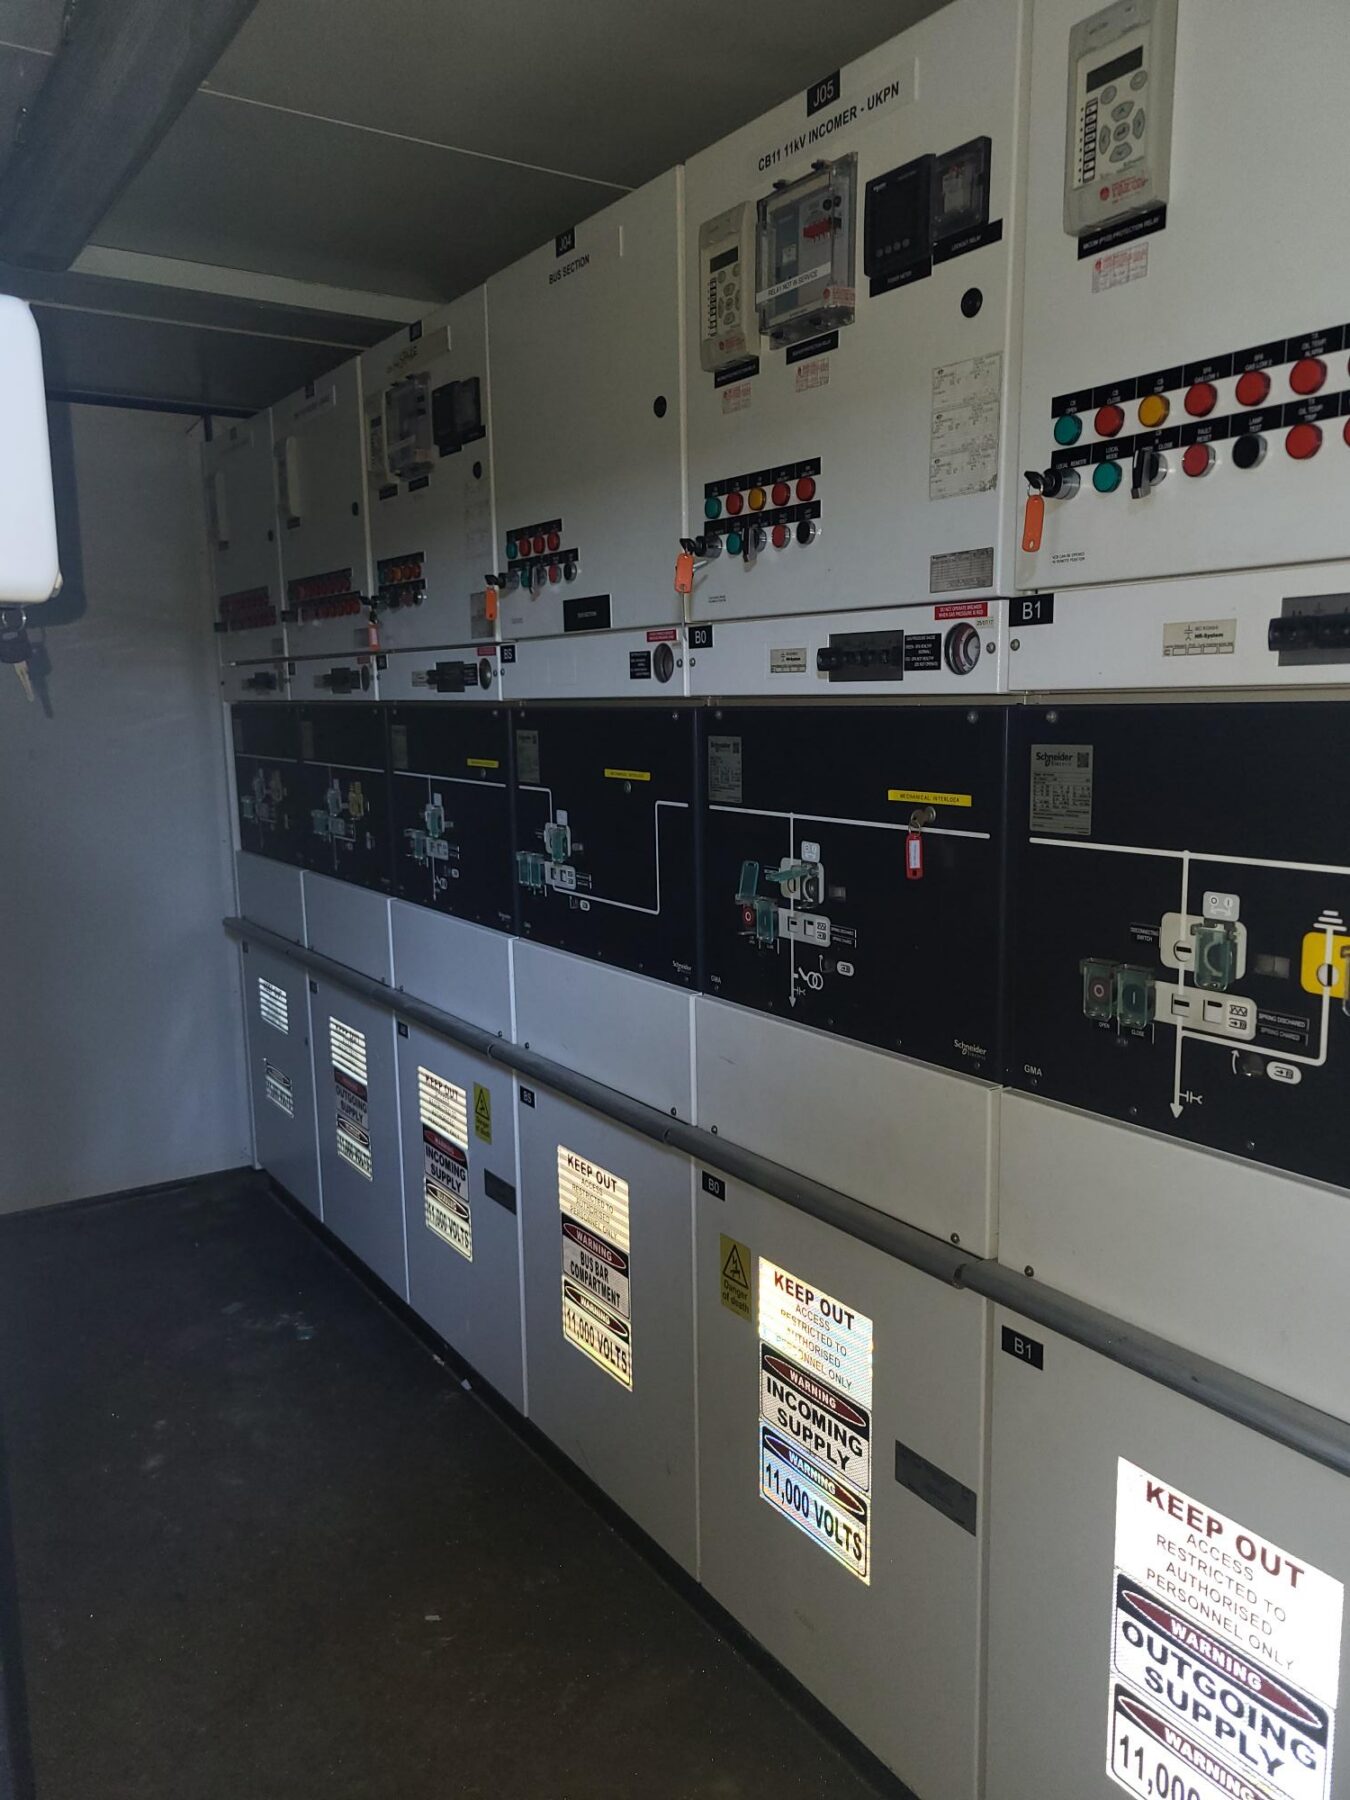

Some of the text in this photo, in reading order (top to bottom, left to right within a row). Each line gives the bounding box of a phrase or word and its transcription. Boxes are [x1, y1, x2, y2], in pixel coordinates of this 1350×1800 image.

[813, 80, 834, 108] J05
[758, 149, 780, 171] CB11
[784, 134, 806, 157] 11kV
[808, 106, 857, 144] INCOMER
[867, 81, 900, 110] UKPN
[549, 254, 590, 284] BUS SECTION
[768, 285, 781, 296] RELAY
[782, 281, 792, 290] NOT
[799, 270, 818, 284] SERVICE
[1022, 601, 1041, 620] B1
[695, 630, 707, 644] B0
[1036, 752, 1073, 761] Schneider
[954, 1039, 987, 1055] Schneider
[1131, 1029, 1144, 1037] CLOSE
[1024, 1064, 1042, 1077] GMA
[425, 1145, 466, 1181] INCOMING
[431, 1163, 461, 1193] SUPPLY
[567, 1153, 617, 1193] KEEP OUT
[448, 1215, 469, 1250] VOLTS
[576, 1229, 613, 1261] WARNING
[570, 1261, 621, 1308] COMPARTMENT
[580, 1251, 609, 1281] BUS BAR
[580, 1293, 611, 1325] WARNING
[722, 1279, 749, 1300] Danger
[774, 1271, 854, 1331] KEEP OUT
[780, 1309, 847, 1357] RESTRICTED TO
[795, 1304, 830, 1332] ACCESS
[566, 1309, 628, 1374] 11,000 VOLTS
[1014, 1336, 1031, 1360] B1
[789, 1369, 837, 1409] WARNING
[828, 1369, 853, 1391] ONLY
[767, 1377, 863, 1457] INCOMING
[777, 1408, 850, 1472] SUPPLY
[788, 1450, 836, 1496] WARNING
[765, 1462, 863, 1562] 11,000 VOLTS
[1146, 1481, 1304, 1588] KEEP OUT
[1186, 1532, 1254, 1581] ACCESS
[1156, 1534, 1287, 1623] RESTRICTED TO
[1166, 1561, 1273, 1636] AUTHORISED
[1146, 1568, 1295, 1671] PERSONNEL ONLY
[1169, 1616, 1263, 1691] WARNING
[1122, 1620, 1317, 1771] OUTGOING
[1145, 1666, 1285, 1777] SUPPLY
[1164, 1726, 1260, 1800] WARNING
